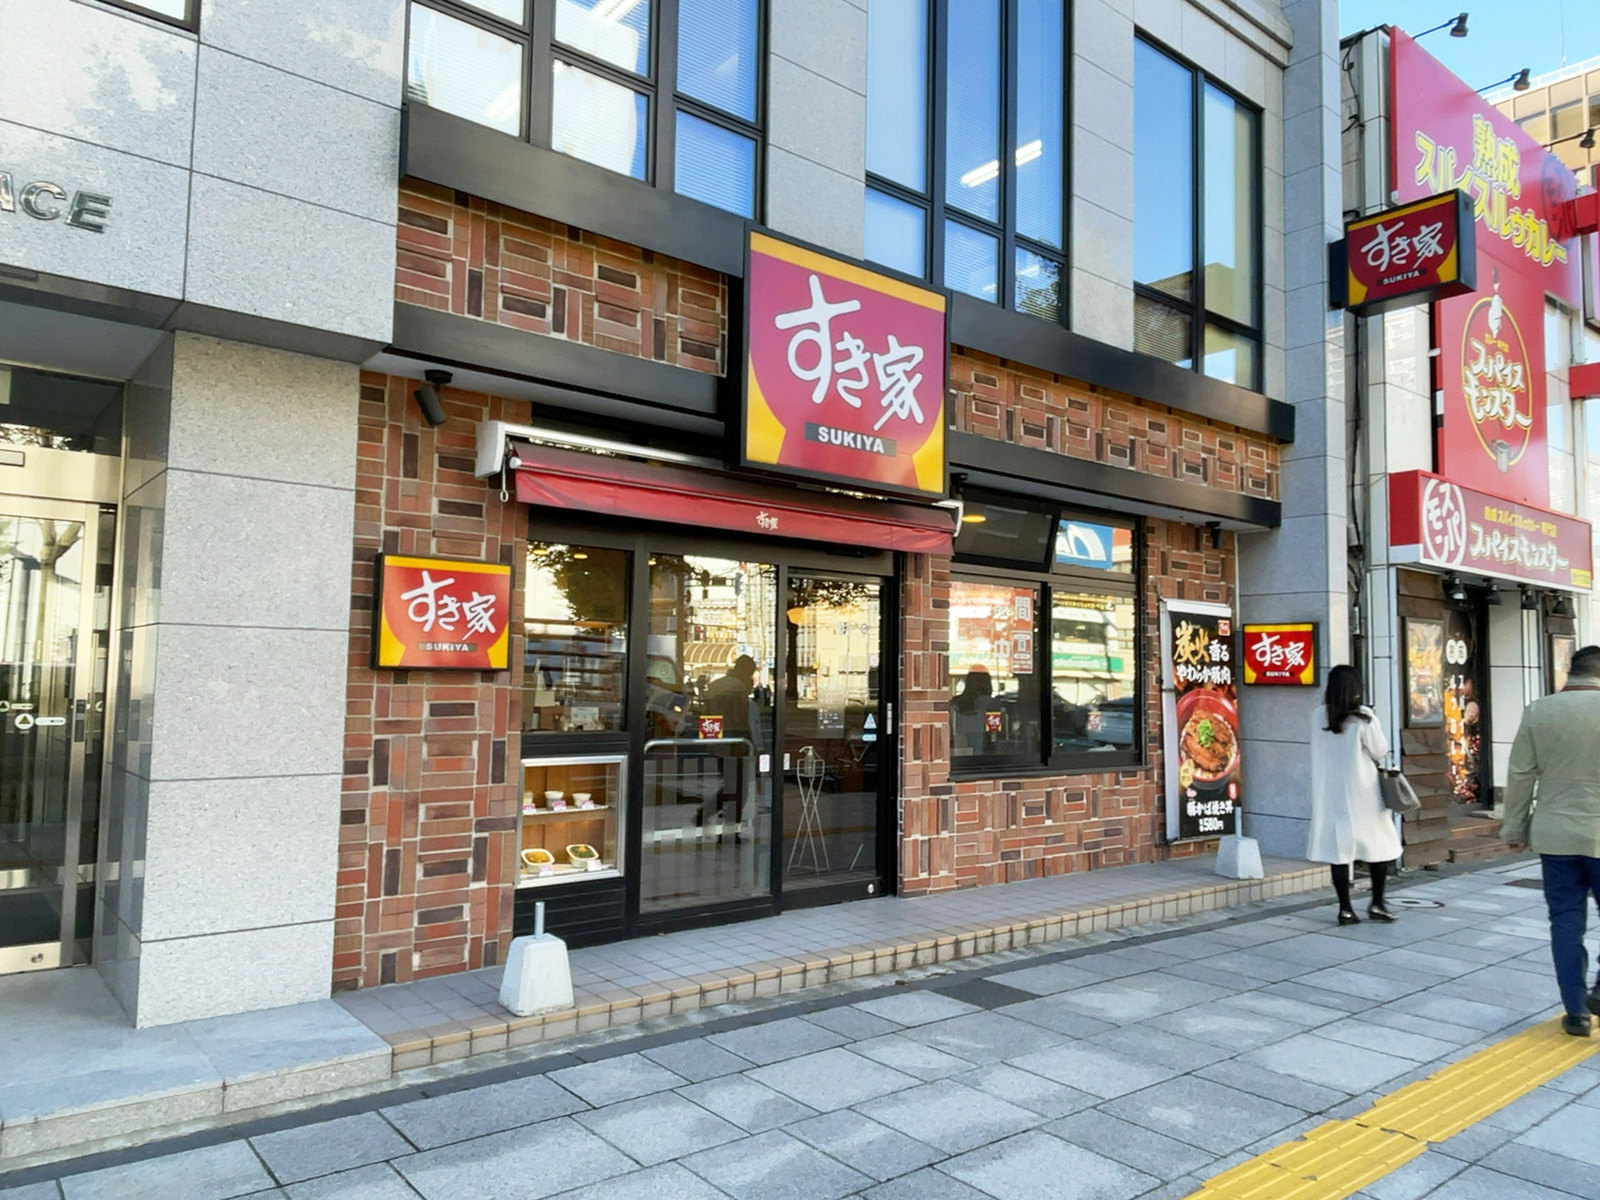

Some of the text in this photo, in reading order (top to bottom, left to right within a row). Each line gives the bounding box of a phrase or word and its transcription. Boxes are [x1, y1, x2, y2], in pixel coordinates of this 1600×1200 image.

[1360, 221, 1445, 272] すき家
[1382, 270, 1420, 285] SUKIYA
[774, 273, 925, 431] すき家
[1470, 337, 1526, 393] スパイス
[1462, 366, 1533, 430] モンスター
[817, 426, 885, 454] SUKIYA
[755, 510, 779, 531] すき家
[1470, 522, 1570, 573] スパイスモンスター
[400, 570, 497, 641] すき家
[426, 643, 470, 653] SUKIYA
[1251, 632, 1306, 671] すき家
